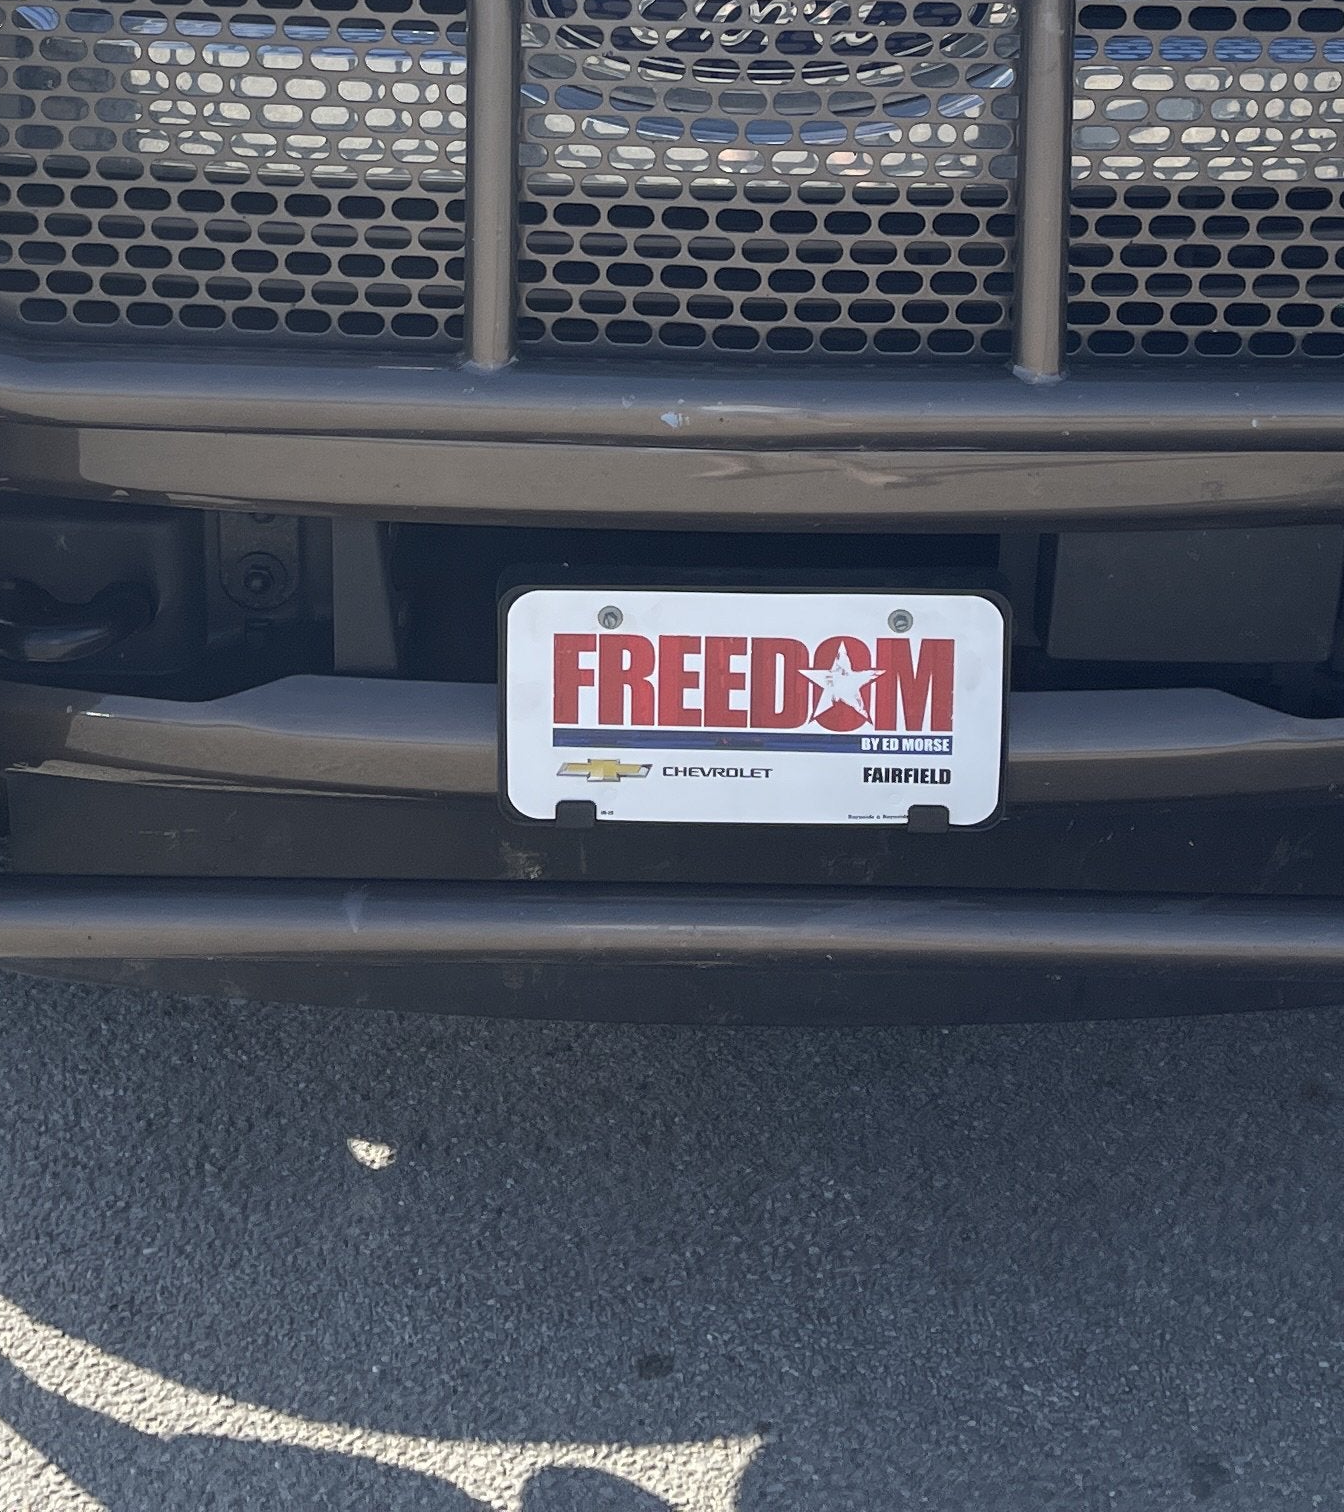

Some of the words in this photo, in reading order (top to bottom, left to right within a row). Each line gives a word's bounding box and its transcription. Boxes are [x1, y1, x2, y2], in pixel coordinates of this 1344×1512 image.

[553, 632, 955, 732] FREEDOM
[861, 737, 880, 751] BY
[882, 738, 900, 751] ED
[902, 738, 950, 752] MORSE
[662, 765, 774, 779] CHEVROLET
[863, 767, 952, 785] FAIRFIELD
